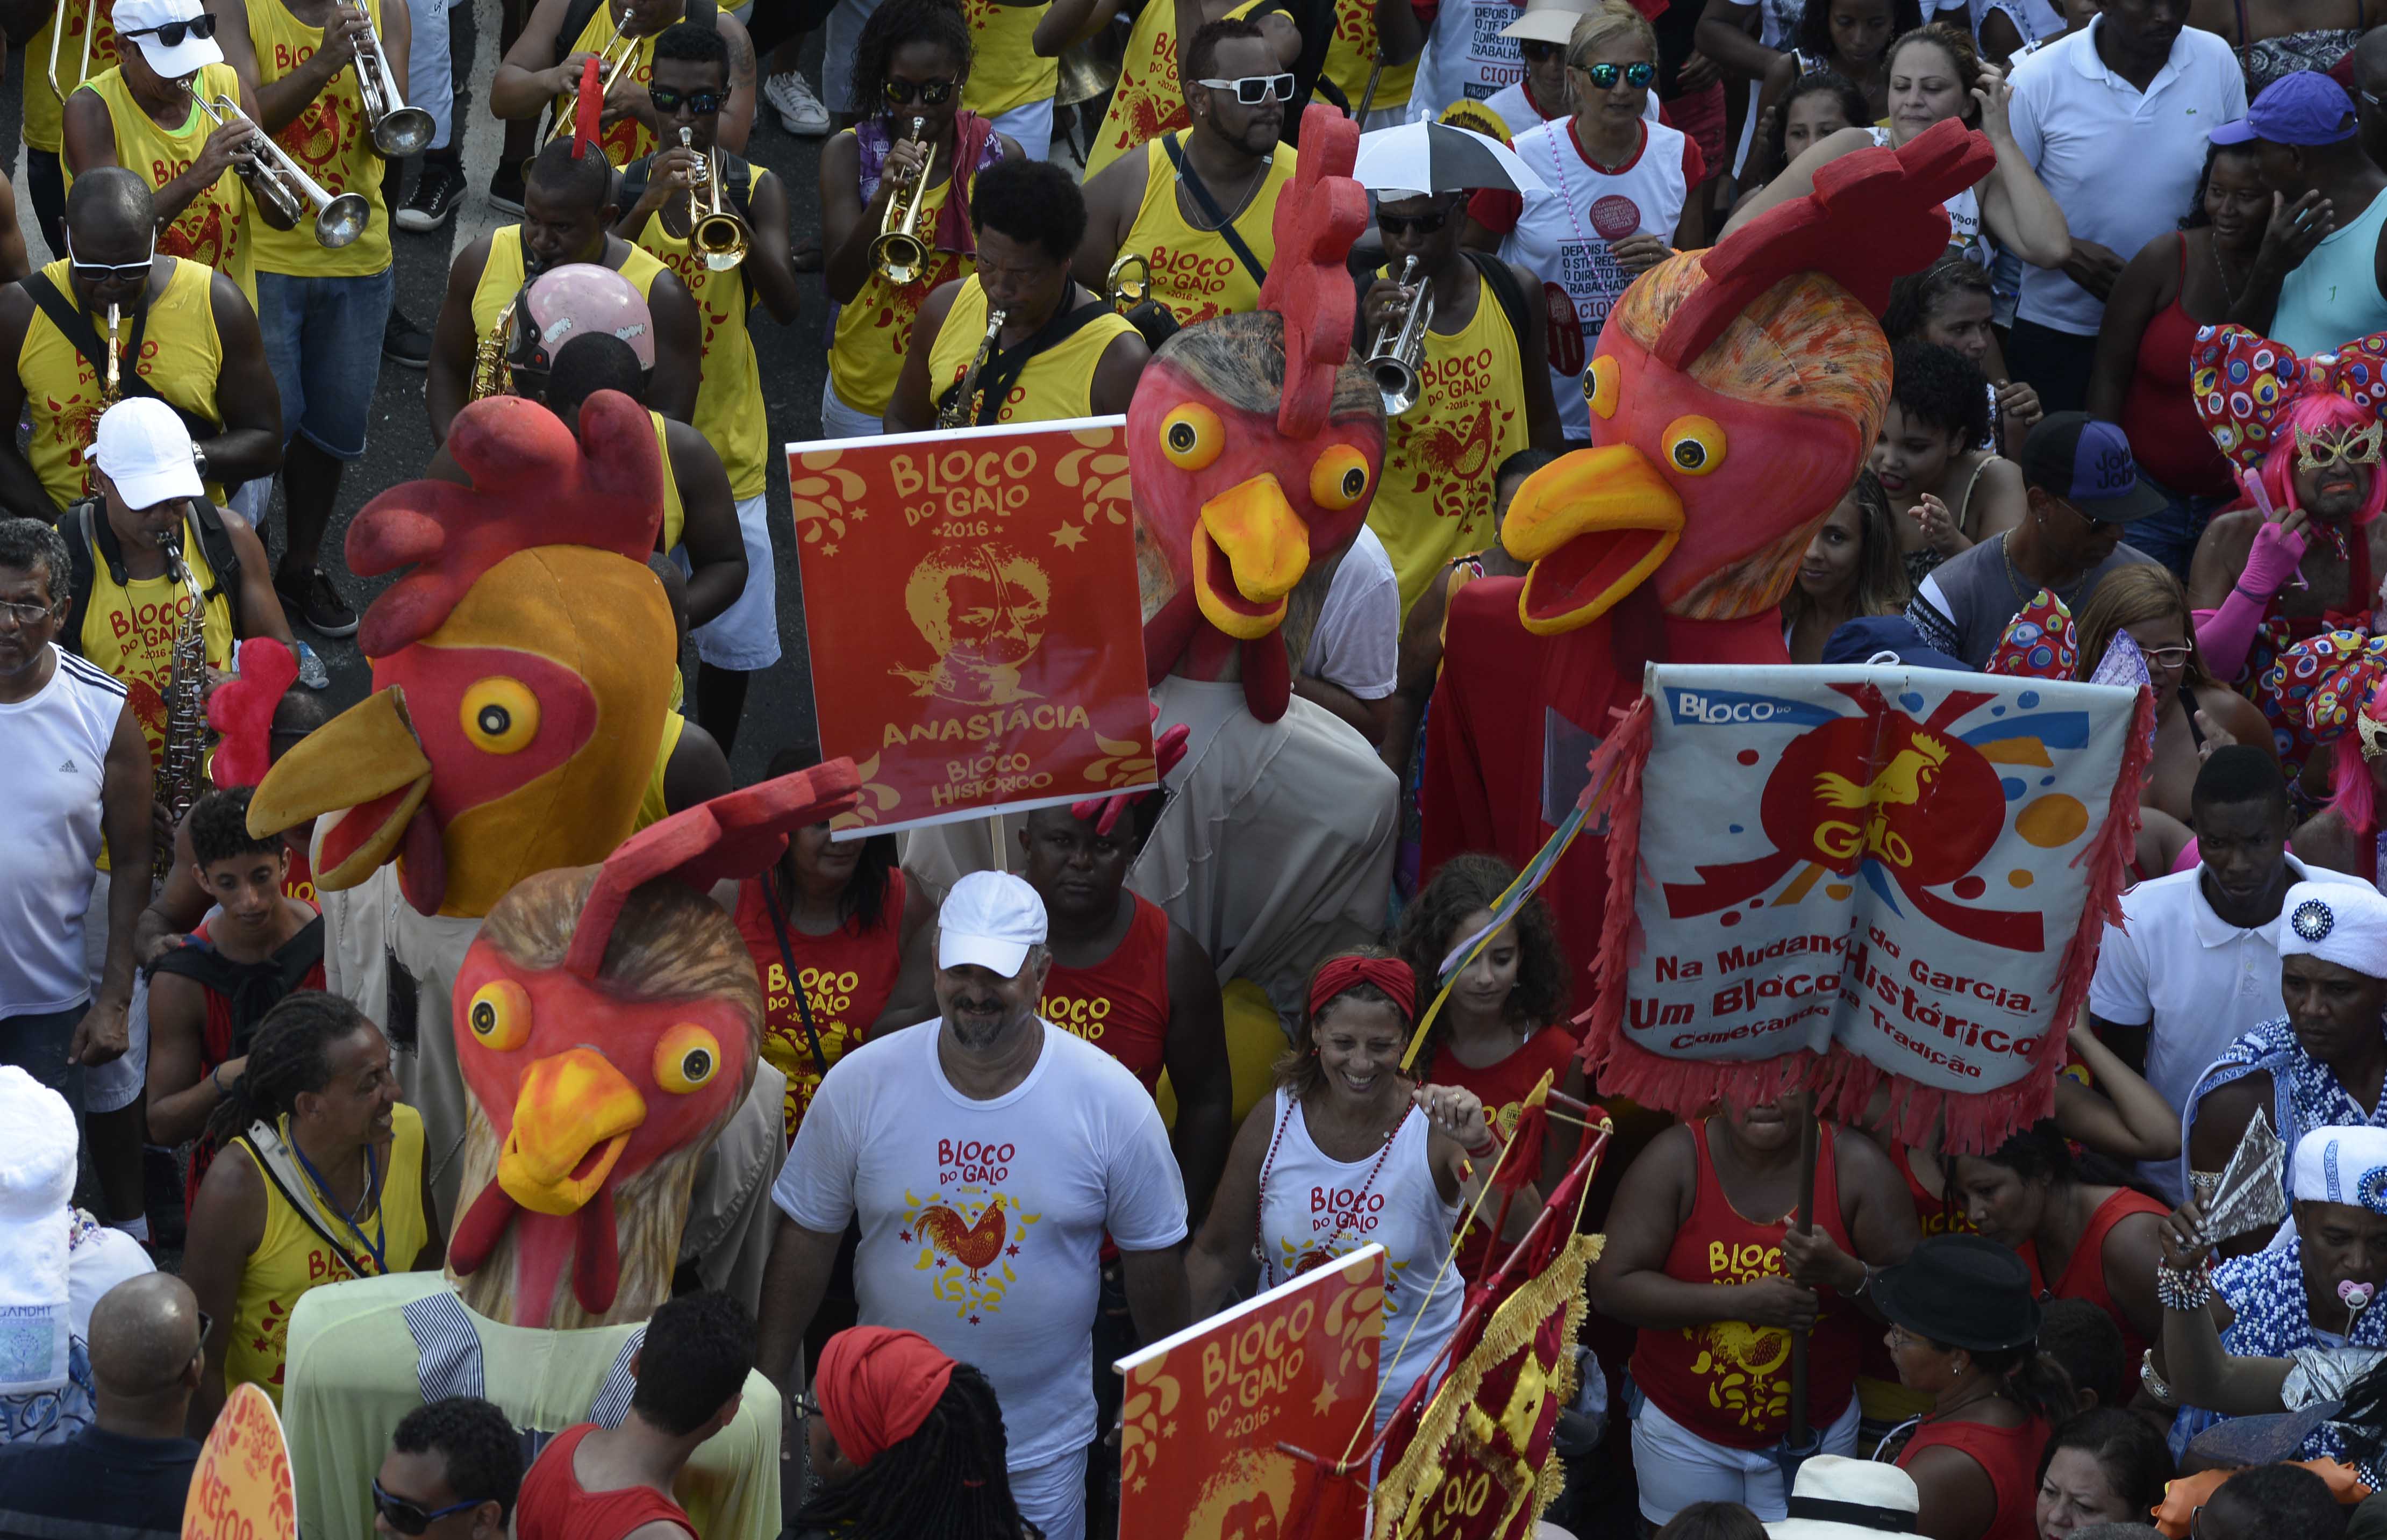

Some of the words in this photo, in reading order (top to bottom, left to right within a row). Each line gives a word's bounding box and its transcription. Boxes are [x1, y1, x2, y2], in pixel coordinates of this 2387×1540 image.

[1475, 8, 1508, 20] DEPOIS
[1475, 19, 1482, 29] O
[1483, 20, 1499, 32] STF
[275, 44, 313, 70] BLO
[1471, 42, 1525, 61] TRABALHA
[1149, 62, 1162, 73] DO
[1481, 66, 1524, 85] CIQU
[1948, 212, 1978, 227] VIDOR
[1149, 246, 1235, 277] BLOCO
[1562, 244, 1601, 256] DEPOIS
[1563, 258, 1570, 268] O
[1173, 273, 1226, 296] GALO
[1564, 270, 1571, 281] O
[1170, 289, 1193, 302] 2016
[1420, 348, 1492, 389] BLOCO
[1428, 390, 1444, 407] DO
[1448, 374, 1491, 399] GALO
[1449, 399, 1469, 411] 2016
[890, 446, 1038, 499] BLOCO
[904, 501, 937, 527] DO
[946, 485, 1030, 517] GALO
[942, 520, 989, 537] 2016
[110, 596, 191, 640] BLOCO
[120, 639, 138, 657] DO
[145, 649, 167, 660] 2016
[1680, 692, 1774, 724] BLOCO
[1776, 706, 1791, 714] DO
[883, 703, 1091, 749] ANASTÁCIA
[946, 753, 1031, 783] BLOCO
[931, 772, 1054, 808] HISTÓRICO
[1656, 955, 1703, 983] Na
[1717, 931, 1852, 976] Mudanç
[1868, 920, 1901, 959] do
[1909, 958, 2038, 1013] Garcia.
[768, 996, 789, 1012] DO
[1034, 995, 1110, 1023] LOCO
[1630, 998, 1695, 1029] Um
[1670, 1005, 1831, 1049] Começando
[1869, 1004, 1982, 1078] Tradição
[938, 1138, 1015, 1167] BLOCO
[940, 1171, 957, 1185] DO
[963, 1164, 1008, 1186] GALO
[1311, 1186, 1385, 1214] BLOCO
[1312, 1217, 1330, 1231] DO
[1336, 1211, 1378, 1234] GALO
[1710, 1241, 1781, 1274] BLOC
[1202, 1299, 1314, 1399] BLOCO
[1207, 1394, 1232, 1433] DO
[1239, 1348, 1304, 1408] GALO
[1233, 1405, 1269, 1438] 2016
